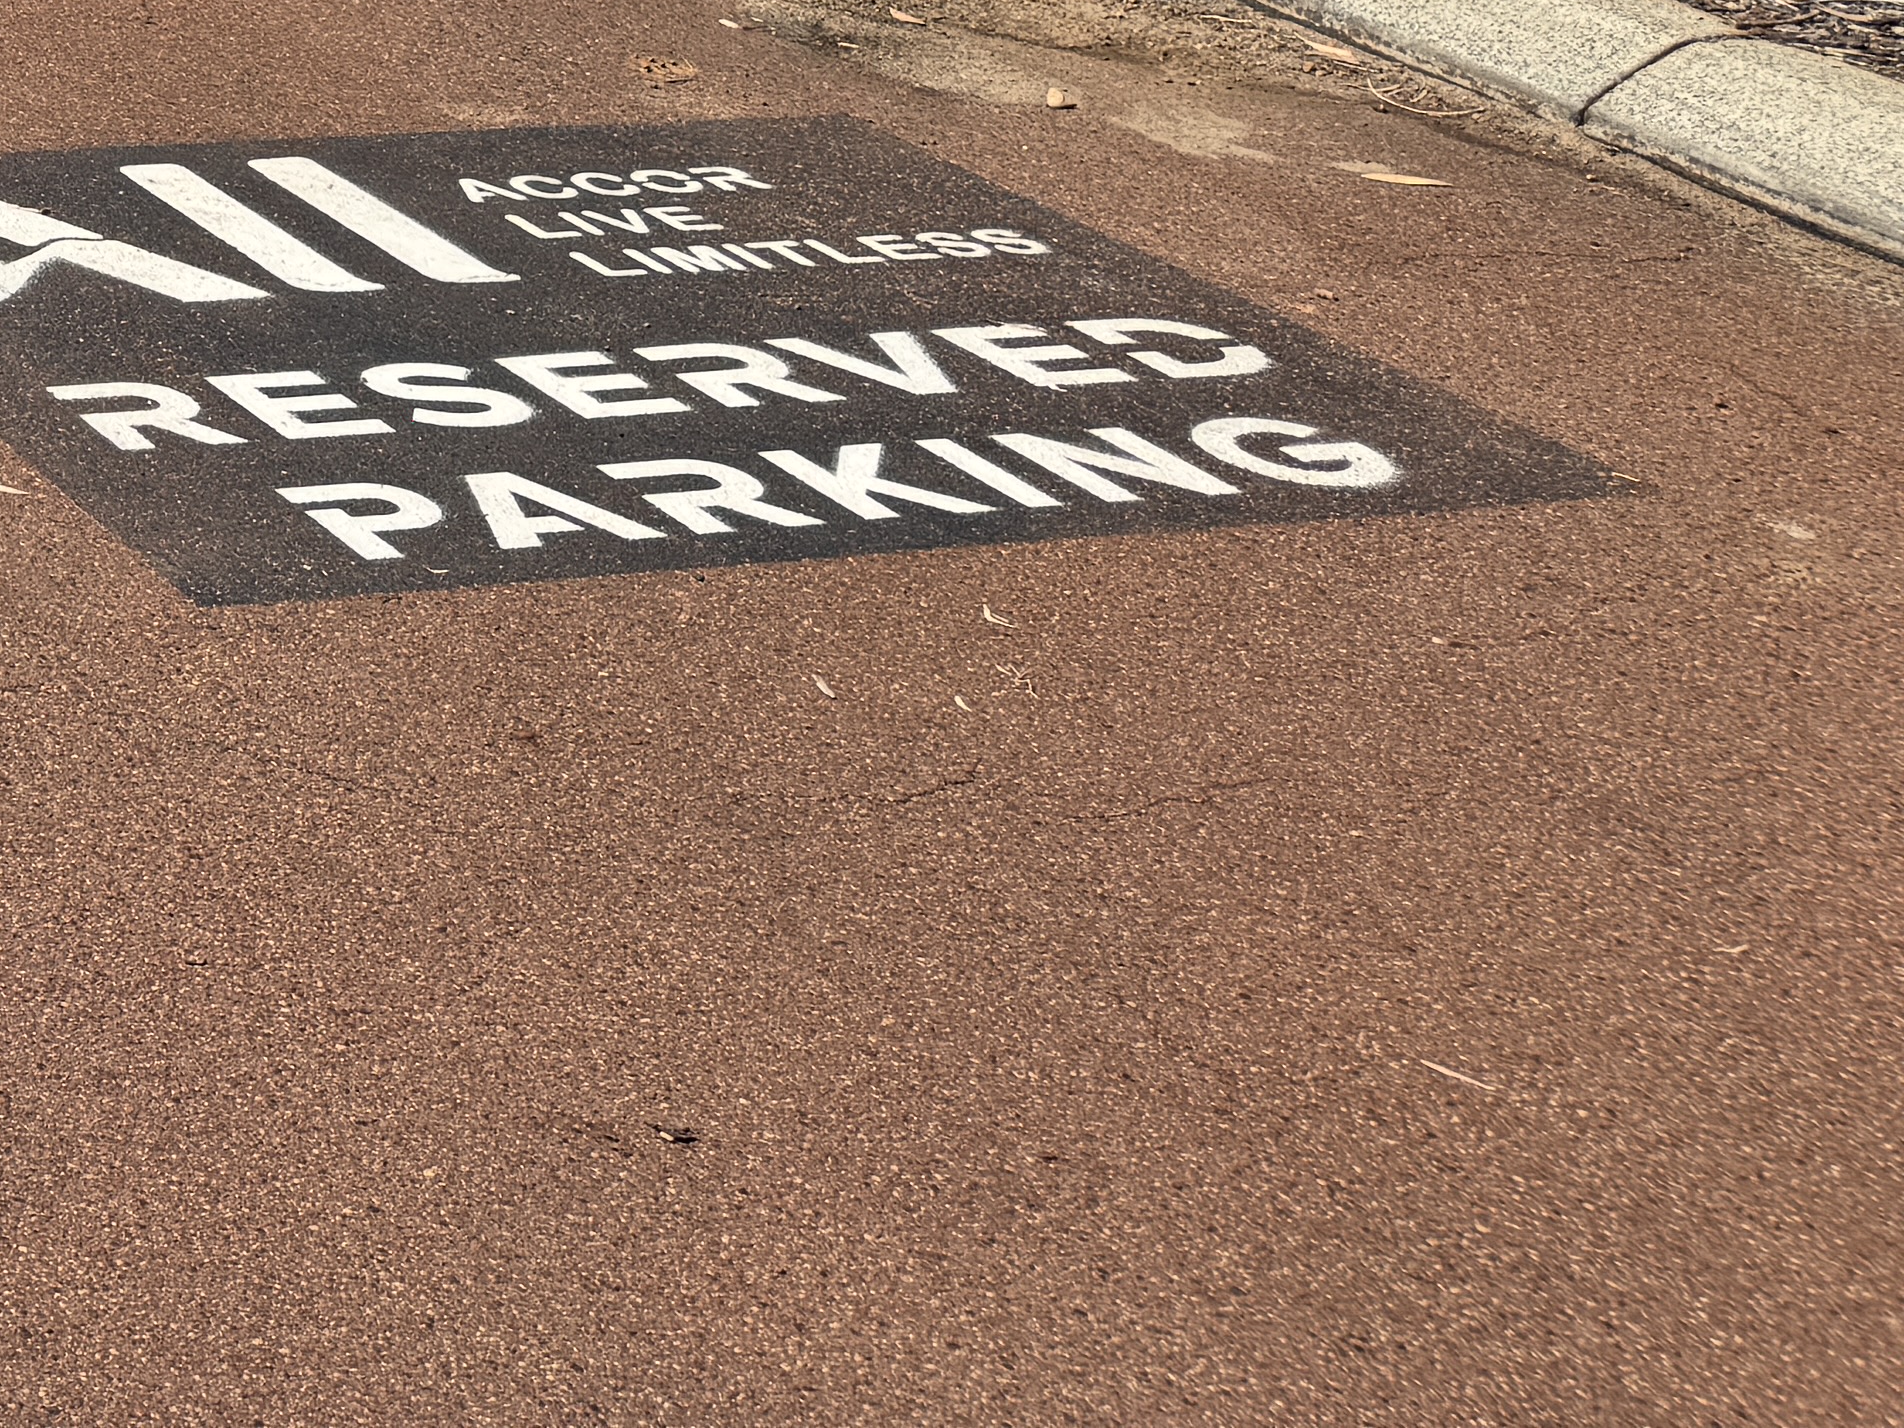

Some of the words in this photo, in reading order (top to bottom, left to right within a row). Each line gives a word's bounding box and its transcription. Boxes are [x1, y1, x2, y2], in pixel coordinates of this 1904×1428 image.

[458, 166, 774, 204] ACCOR
[504, 205, 725, 240] LIVE
[568, 228, 1052, 278] LIMITLESS
[48, 316, 1273, 452] RESERVED
[277, 415, 1404, 562] PARKING
